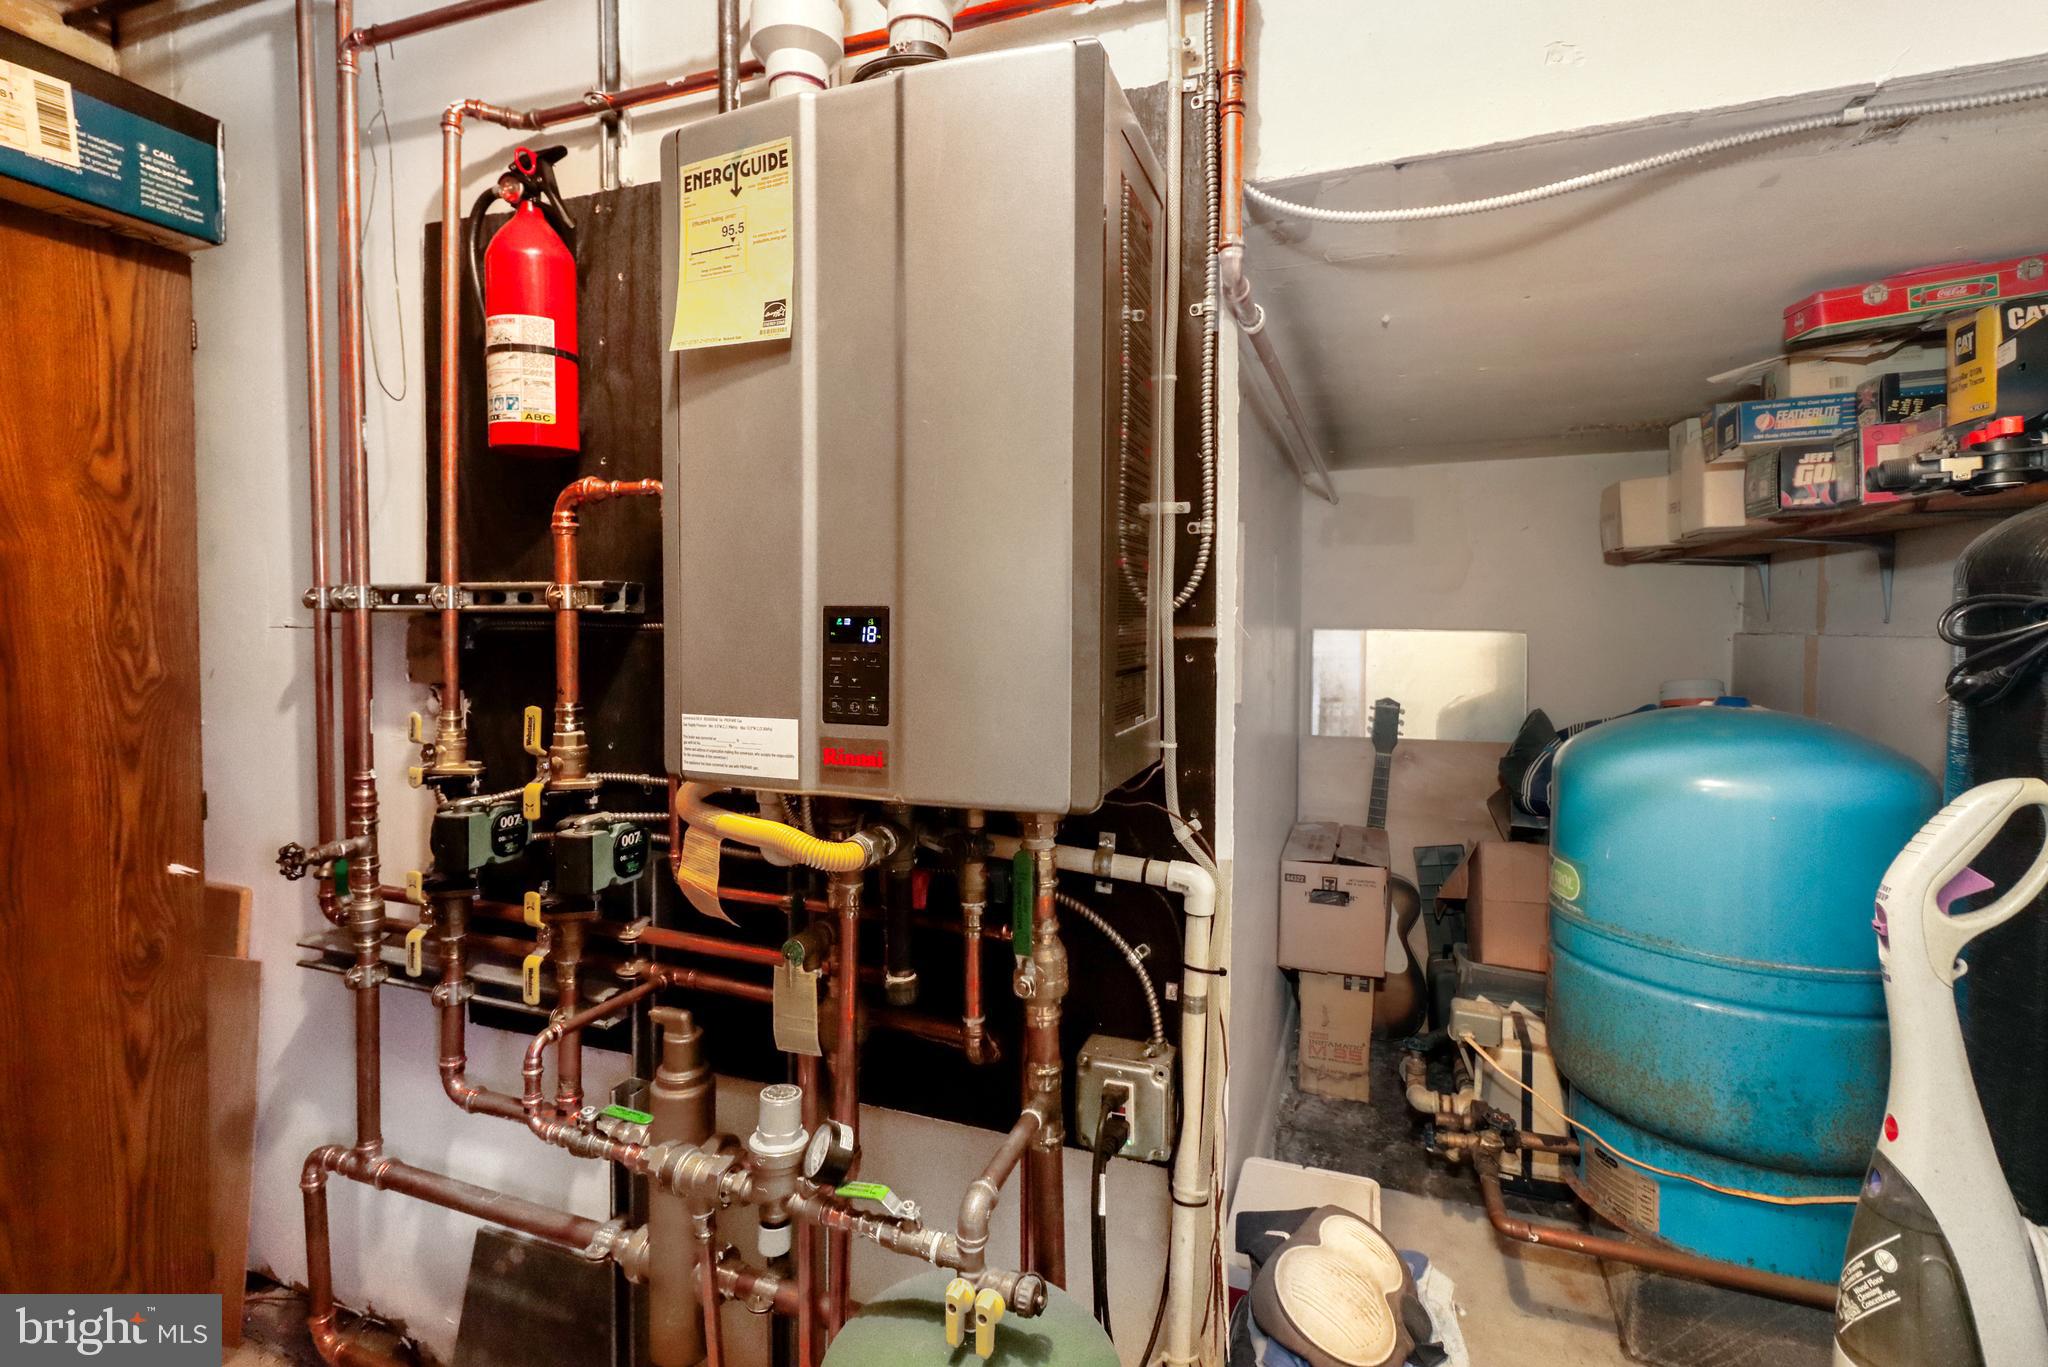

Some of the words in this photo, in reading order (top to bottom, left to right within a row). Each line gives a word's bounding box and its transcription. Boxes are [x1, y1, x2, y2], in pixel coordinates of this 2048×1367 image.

[152, 149, 176, 163] CALL
[684, 148, 789, 197] ENERGYGUIDE
[721, 221, 745, 238] 95.5
[1955, 331, 1974, 358] CAT
[525, 413, 551, 422] ABC
[1776, 405, 1841, 421] FEATHERLITE
[1798, 452, 1834, 464] JEFF
[862, 626, 877, 643] 18
[823, 747, 884, 769] Rinnai
[1852, 1280, 1870, 1296] Wood
[1867, 1275, 1884, 1288] Floor
[1857, 1286, 1883, 1303] Cleaning
[1861, 1289, 1897, 1310] Concentrate
